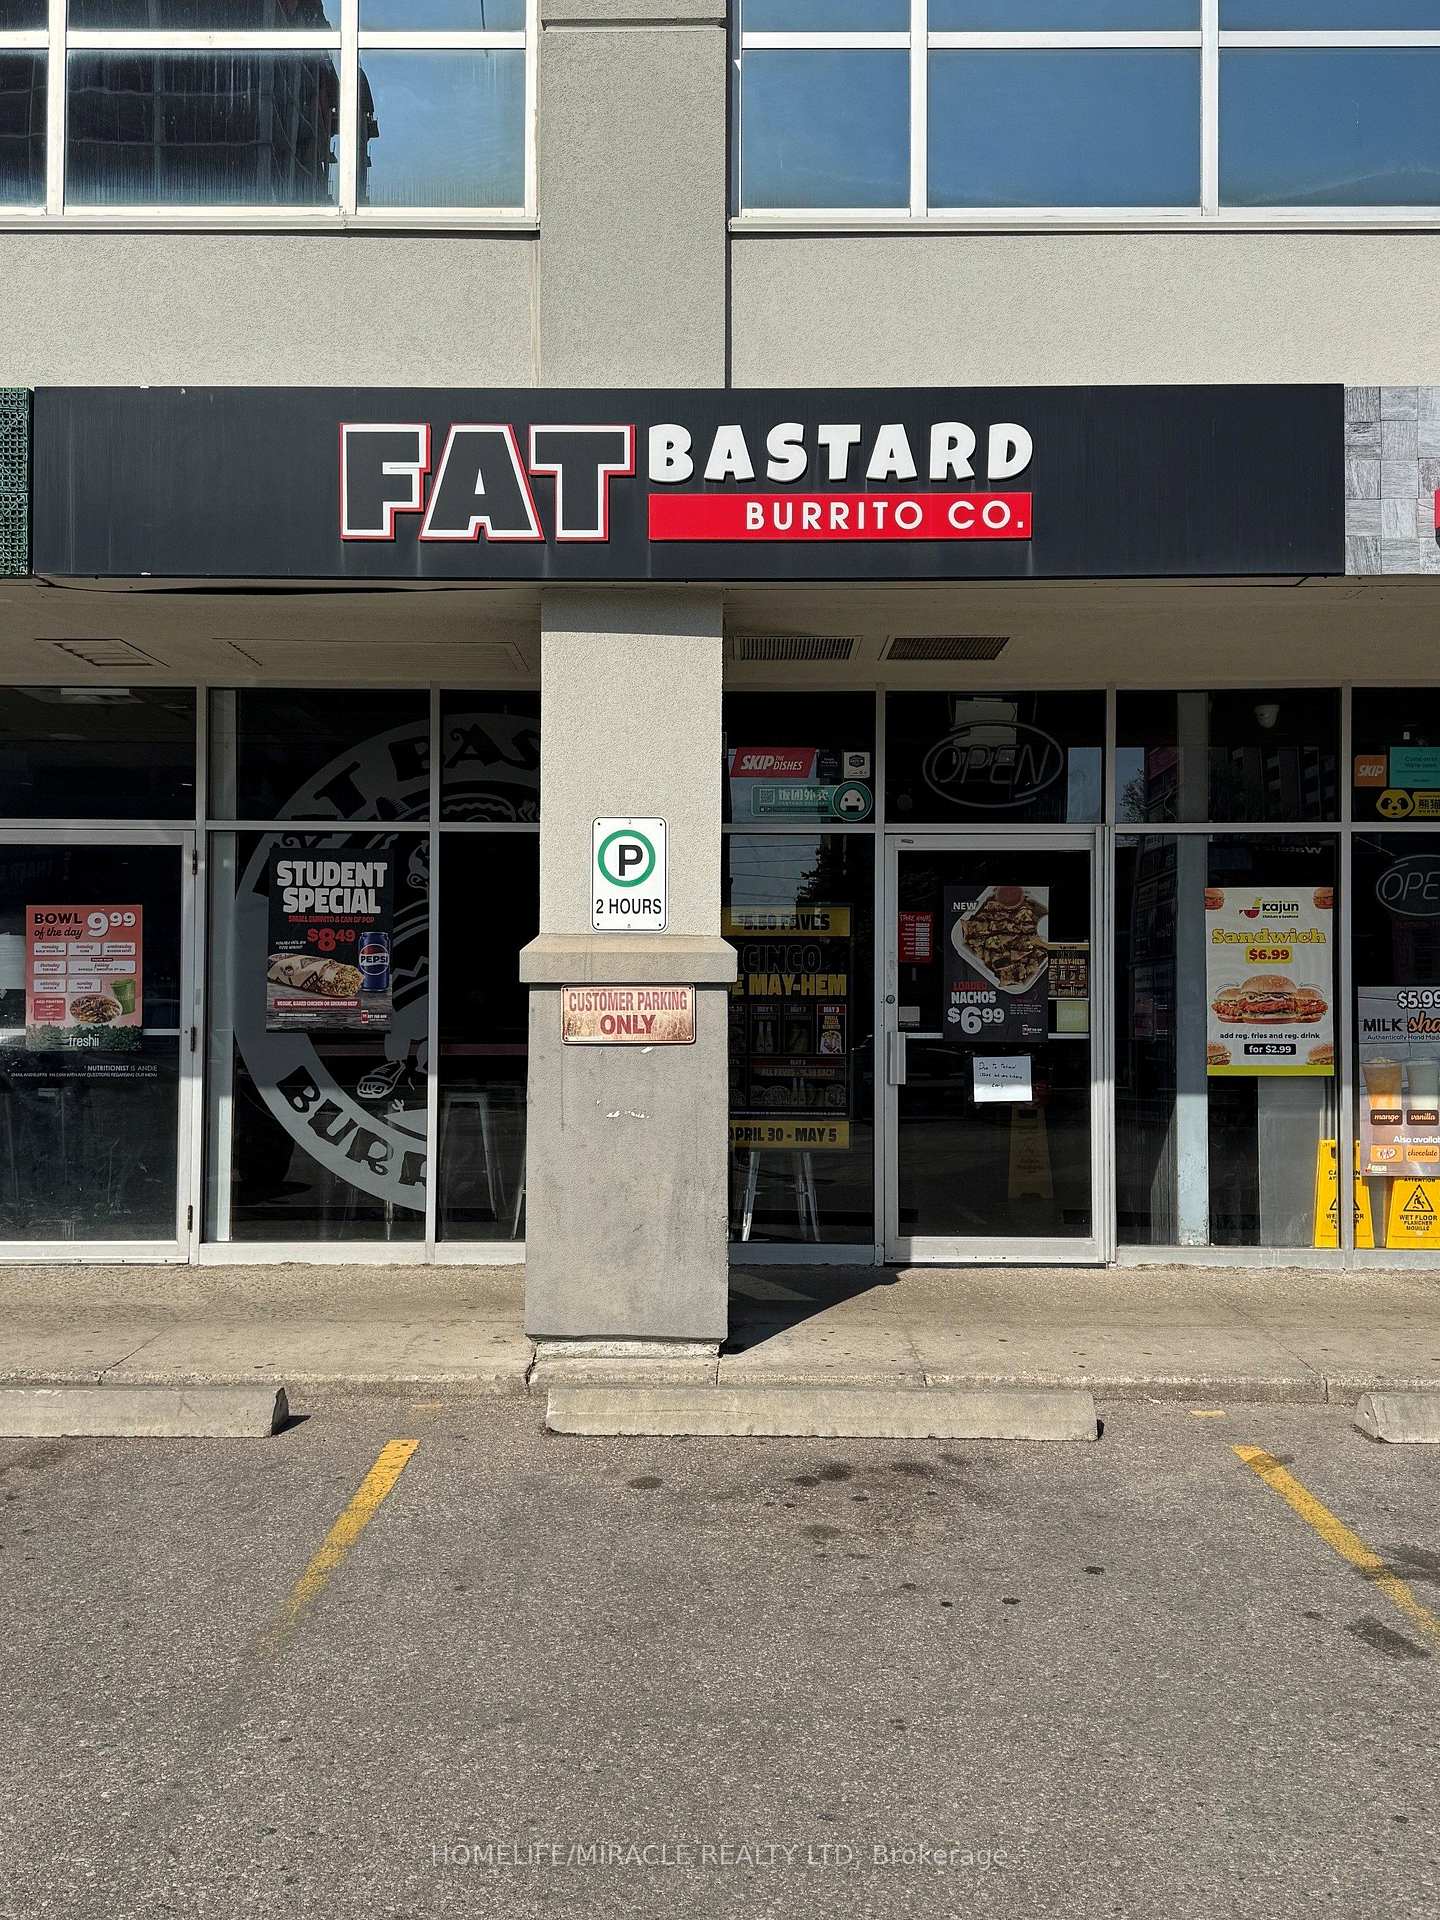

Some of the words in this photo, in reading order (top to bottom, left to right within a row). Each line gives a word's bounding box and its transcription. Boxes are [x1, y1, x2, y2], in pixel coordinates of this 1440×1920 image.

[340, 423, 636, 542] FAT
[648, 422, 1033, 482] BASTARD
[746, 501, 923, 530] BURRITO
[948, 500, 1024, 530] CO.
[740, 755, 775, 770] SKIP
[774, 760, 803, 770] DISHES
[931, 744, 1050, 784] OPEN
[1357, 765, 1384, 776] SKIP
[618, 844, 643, 876] P
[277, 861, 387, 887] STUDENT
[283, 887, 381, 913] SPECIAL
[596, 899, 604, 914] 2
[609, 899, 662, 914] HOURS
[953, 902, 977, 910] NEW
[1262, 900, 1299, 914] kajun
[34, 912, 83, 924] BOWL
[34, 926, 45, 940] of
[47, 926, 62, 937] the
[64, 926, 83, 940] day
[1211, 928, 1327, 944] Sandwich
[743, 944, 821, 973] CINCO
[1249, 948, 1290, 961] $6.99
[748, 974, 847, 996] MAY-HEM
[569, 992, 634, 1011] CUSTOMER
[638, 991, 687, 1010] PARKING
[951, 990, 997, 1004] NACHOS
[600, 1015, 656, 1035] ONLY
[1363, 1018, 1403, 1032] MILK
[69, 1034, 100, 1047] freshii
[1249, 1045, 1263, 1053] for
[1265, 1045, 1291, 1053] $2.99
[1374, 1114, 1400, 1122] mango
[1410, 1112, 1436, 1121] vanilla
[767, 1127, 784, 1141] 30
[795, 1128, 826, 1142] MAY
[829, 1128, 837, 1142] 5
[1408, 1148, 1438, 1157] chocolate
